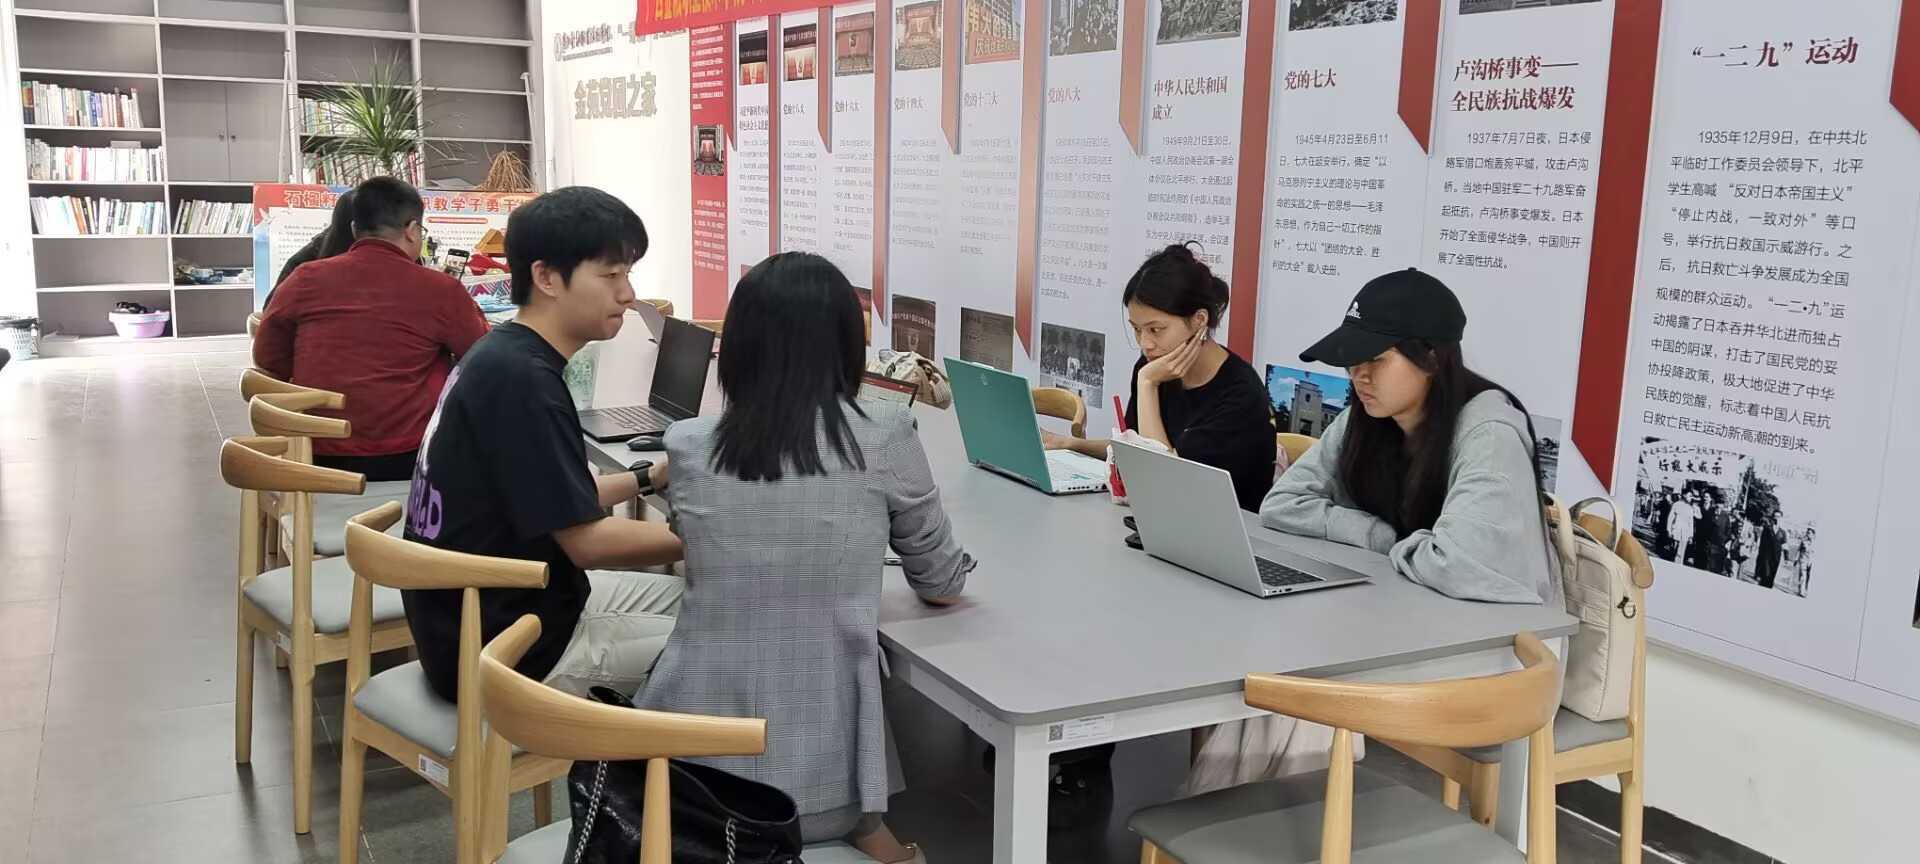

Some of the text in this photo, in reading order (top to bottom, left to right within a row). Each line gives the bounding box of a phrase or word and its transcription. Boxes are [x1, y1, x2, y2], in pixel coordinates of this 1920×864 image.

[1153, 75, 1229, 98] 中华人民共和国
[1284, 67, 1337, 91] 党的七大
[1047, 85, 1081, 104] 党的八大
[1450, 86, 1576, 112] 全民族抗战爆发
[1151, 104, 1173, 121] 成立
